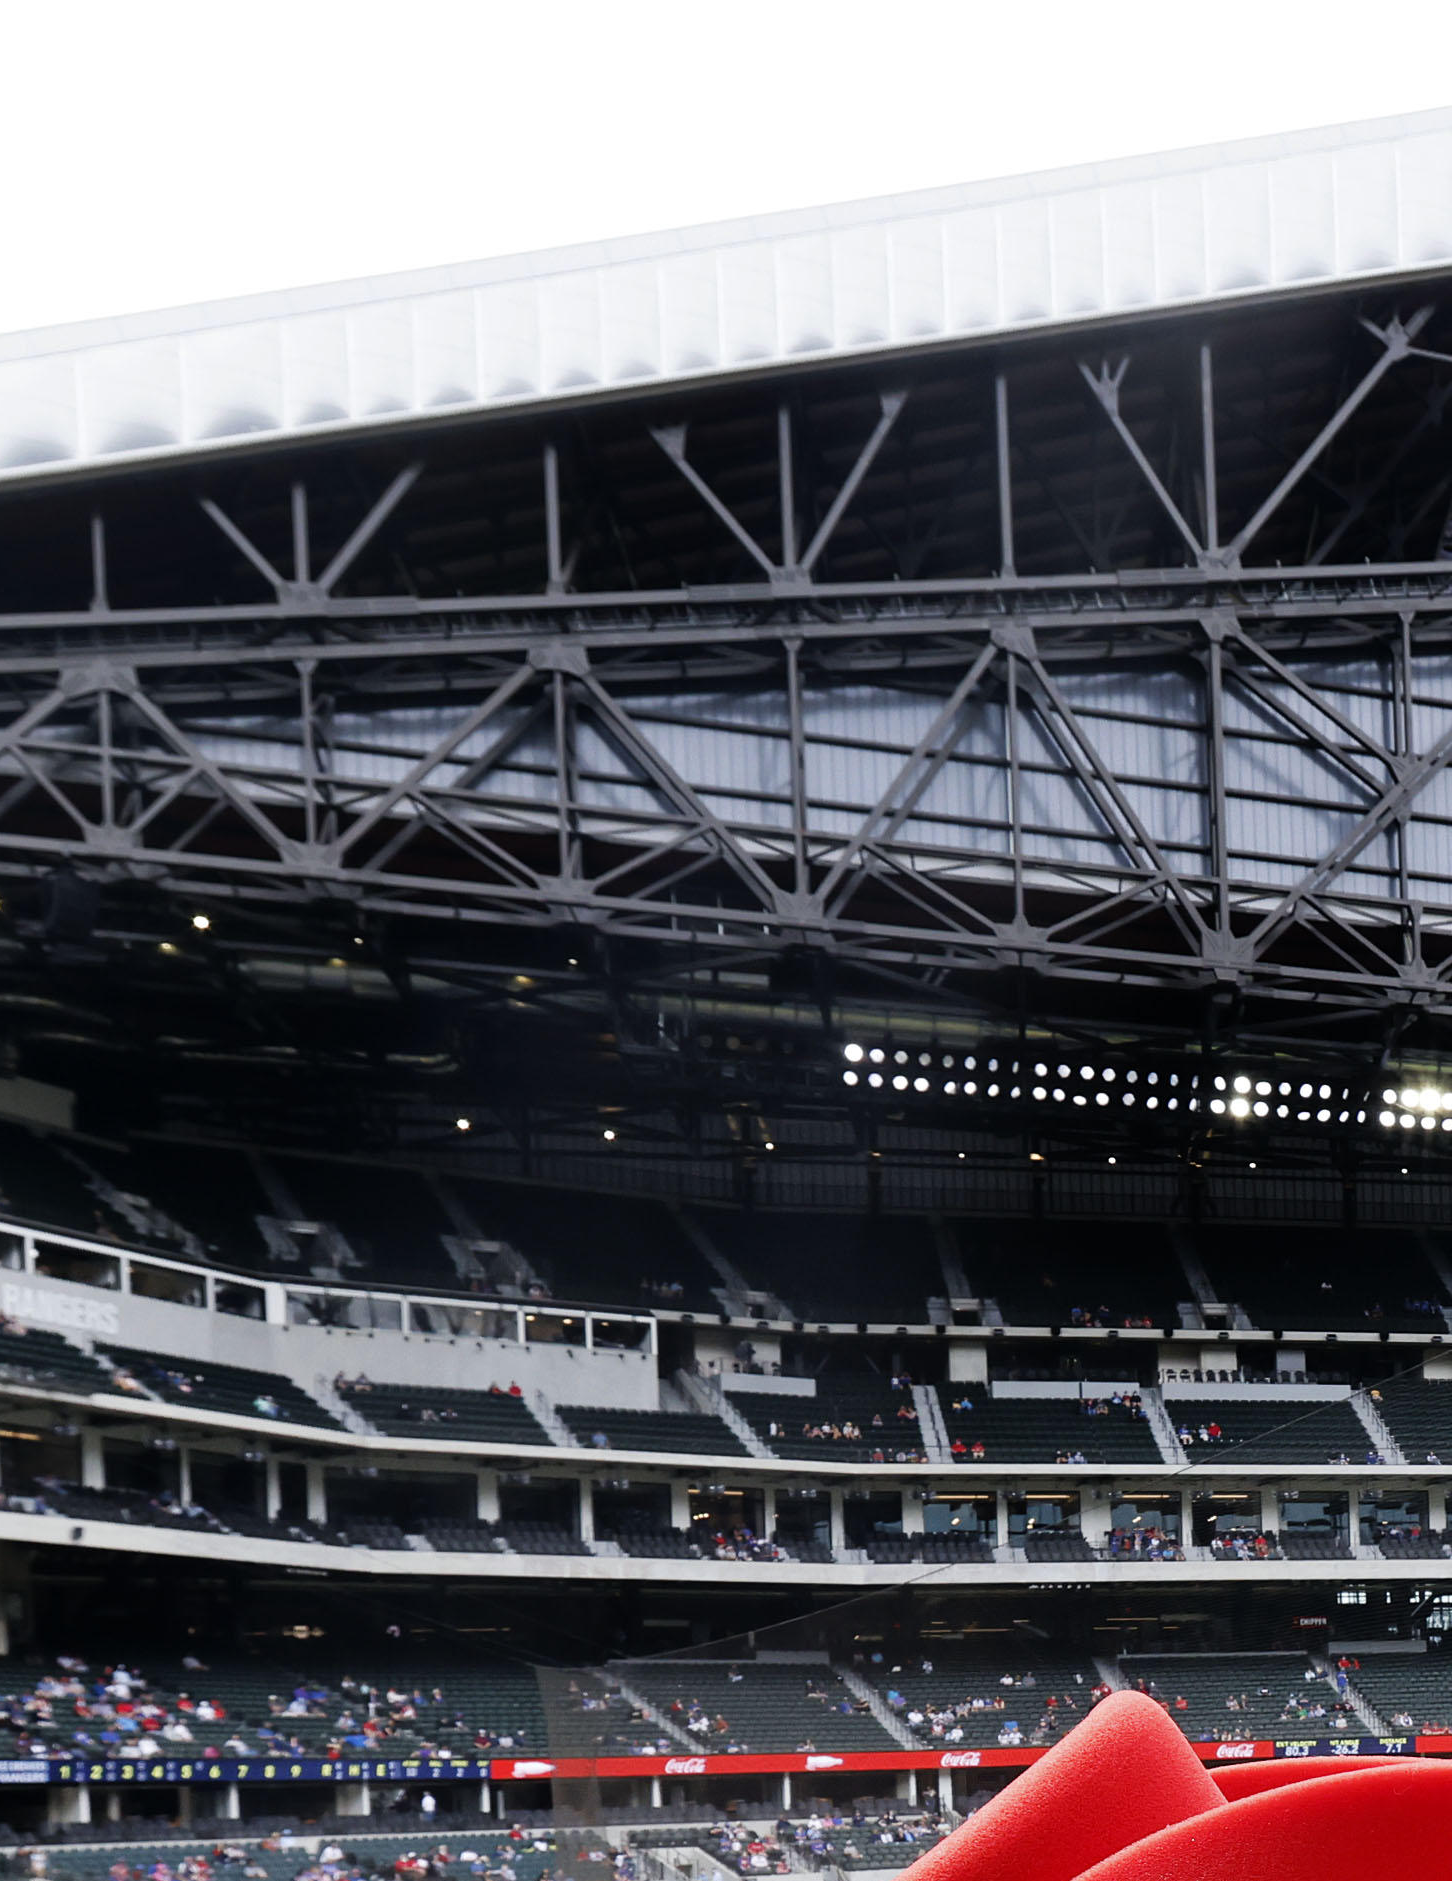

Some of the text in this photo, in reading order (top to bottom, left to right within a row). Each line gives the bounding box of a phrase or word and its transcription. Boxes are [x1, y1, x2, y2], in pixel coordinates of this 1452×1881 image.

[1, 1282, 121, 1335] RANGERS
[1216, 1743, 1255, 1758] Coca-Cola
[1285, 1746, 1309, 1756] 80.3
[1331, 1744, 1358, 1755] -26.2
[1385, 1743, 1402, 1753] 7.1
[665, 1758, 706, 1774] Coca-Cola
[941, 1751, 982, 1767] Coca-Cola
[60, 1765, 71, 1780] 1
[90, 1764, 103, 1780] 2
[121, 1765, 134, 1779] 3
[151, 1765, 163, 1779] 4
[181, 1765, 192, 1779] 5
[209, 1765, 221, 1779] 6
[238, 1765, 248, 1779] 7
[264, 1765, 276, 1779] 8
[291, 1764, 302, 1778] 9
[321, 1764, 332, 1777] R
[349, 1764, 360, 1777] H
[376, 1764, 386, 1777] E
